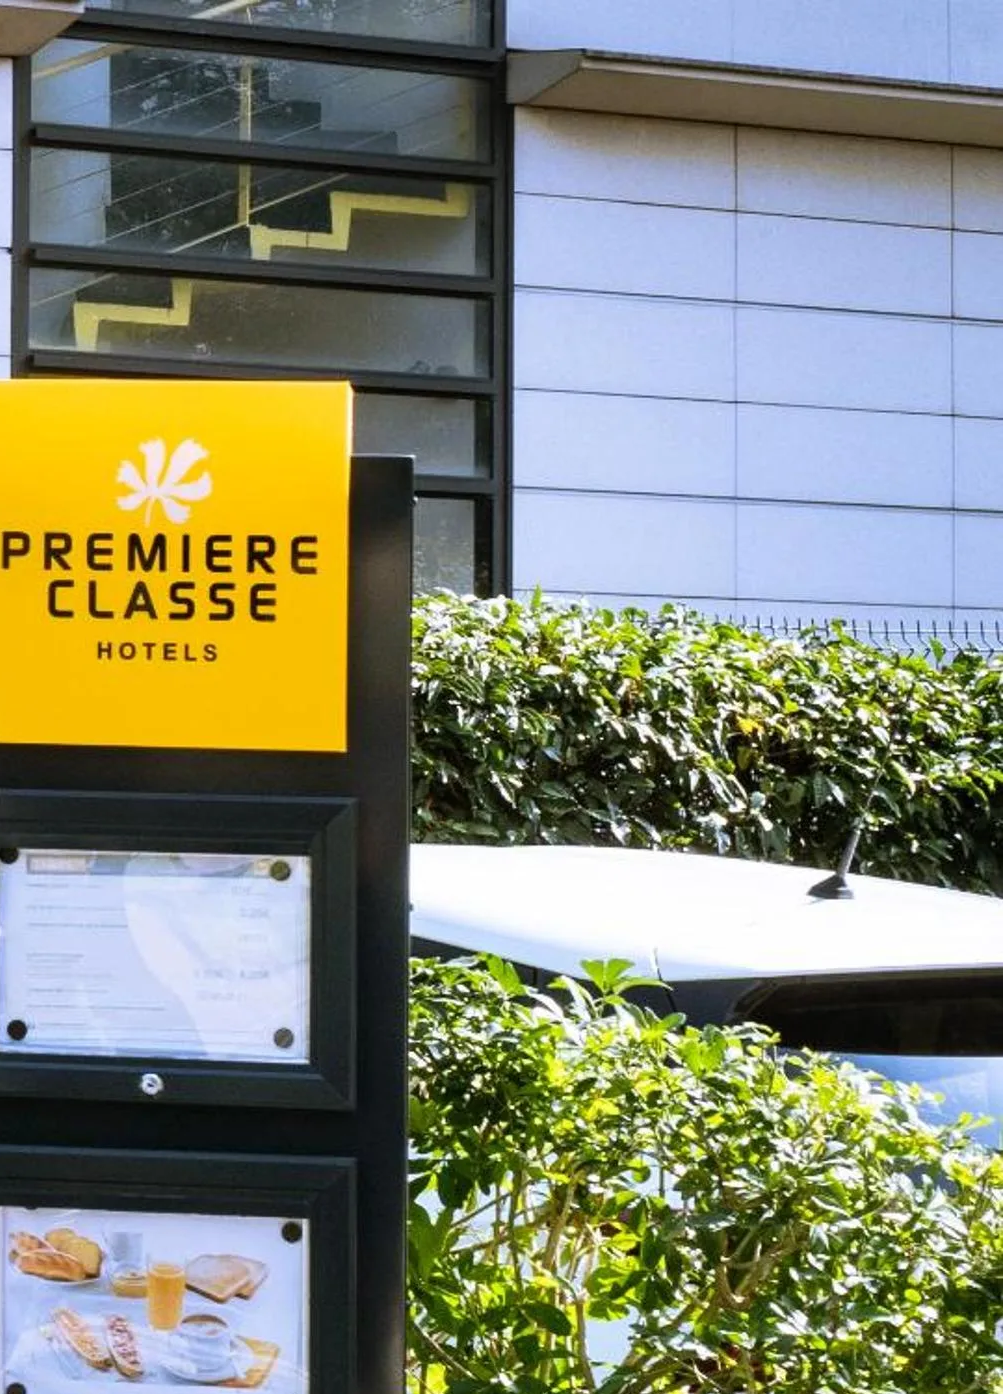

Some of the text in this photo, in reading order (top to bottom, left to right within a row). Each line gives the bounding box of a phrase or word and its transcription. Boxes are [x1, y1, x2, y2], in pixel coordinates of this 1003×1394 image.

[1, 531, 318, 575] PREMIERE
[47, 580, 277, 623] CLASSE
[97, 641, 218, 662] HOTELS
